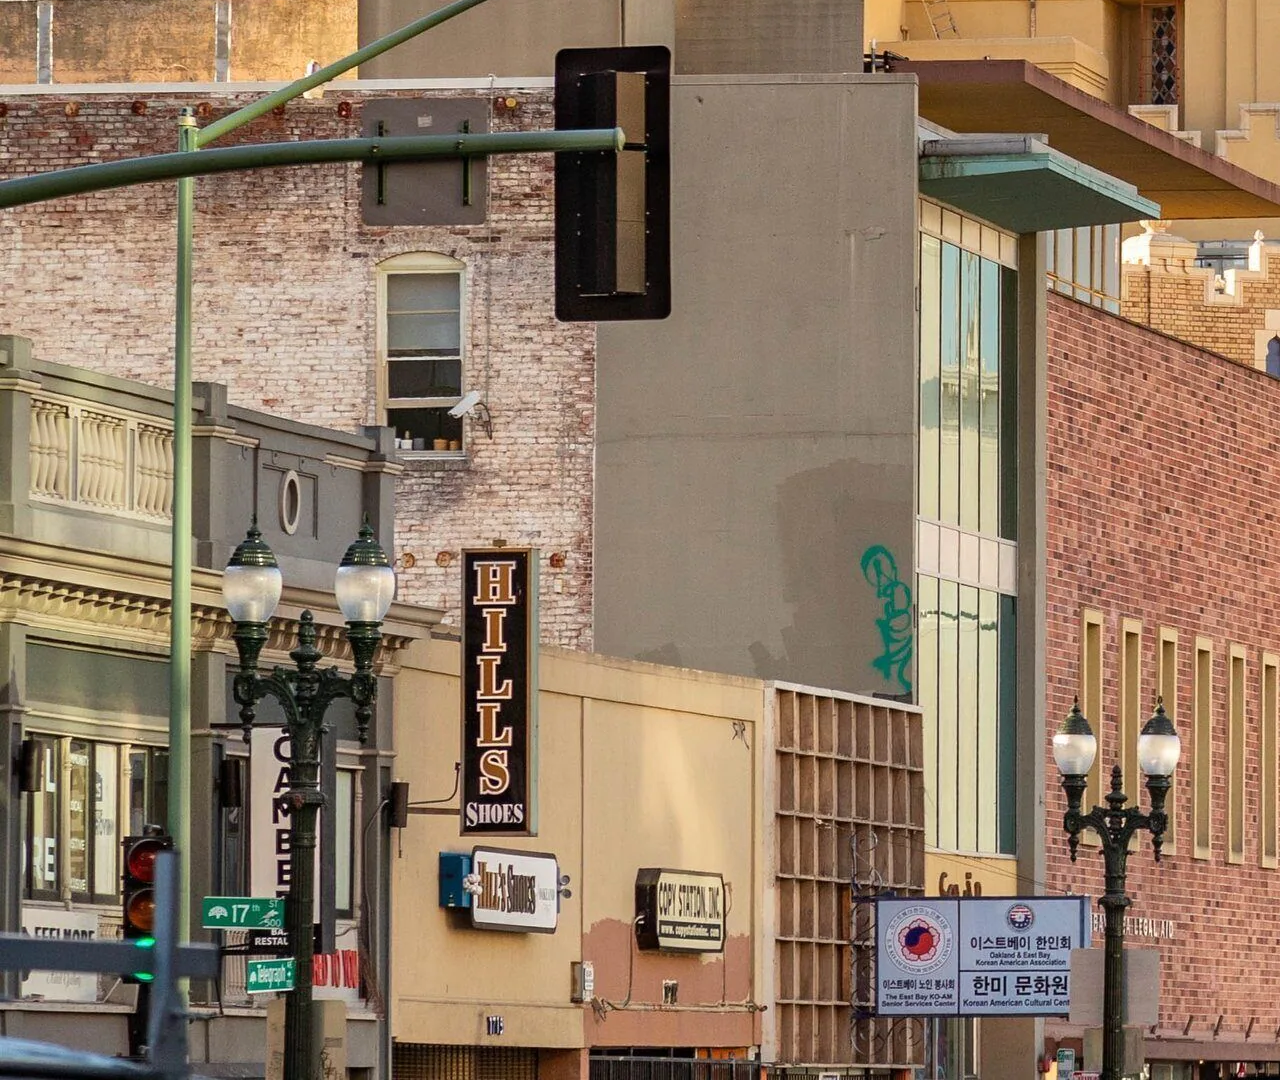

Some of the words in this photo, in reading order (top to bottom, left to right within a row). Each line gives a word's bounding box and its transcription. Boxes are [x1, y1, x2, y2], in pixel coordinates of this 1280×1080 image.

[473, 561, 516, 795] HILLS
[466, 800, 524, 827] SHOES
[659, 881, 676, 917] COPY
[970, 936, 1031, 950] 이스트베이
[1036, 936, 1071, 950] 한인회
[989, 951, 1015, 959] Oakland
[1023, 951, 1037, 959] East
[1038, 952, 1051, 960] Bay
[257, 964, 286, 988] Telegraph
[919, 980, 933, 990] 노인
[973, 976, 1007, 996] 한미
[1014, 976, 1068, 996] 문화원
[915, 993, 928, 1002] Bay
[1024, 999, 1052, 1007] Cultural
[1053, 999, 1070, 1007] Cent
